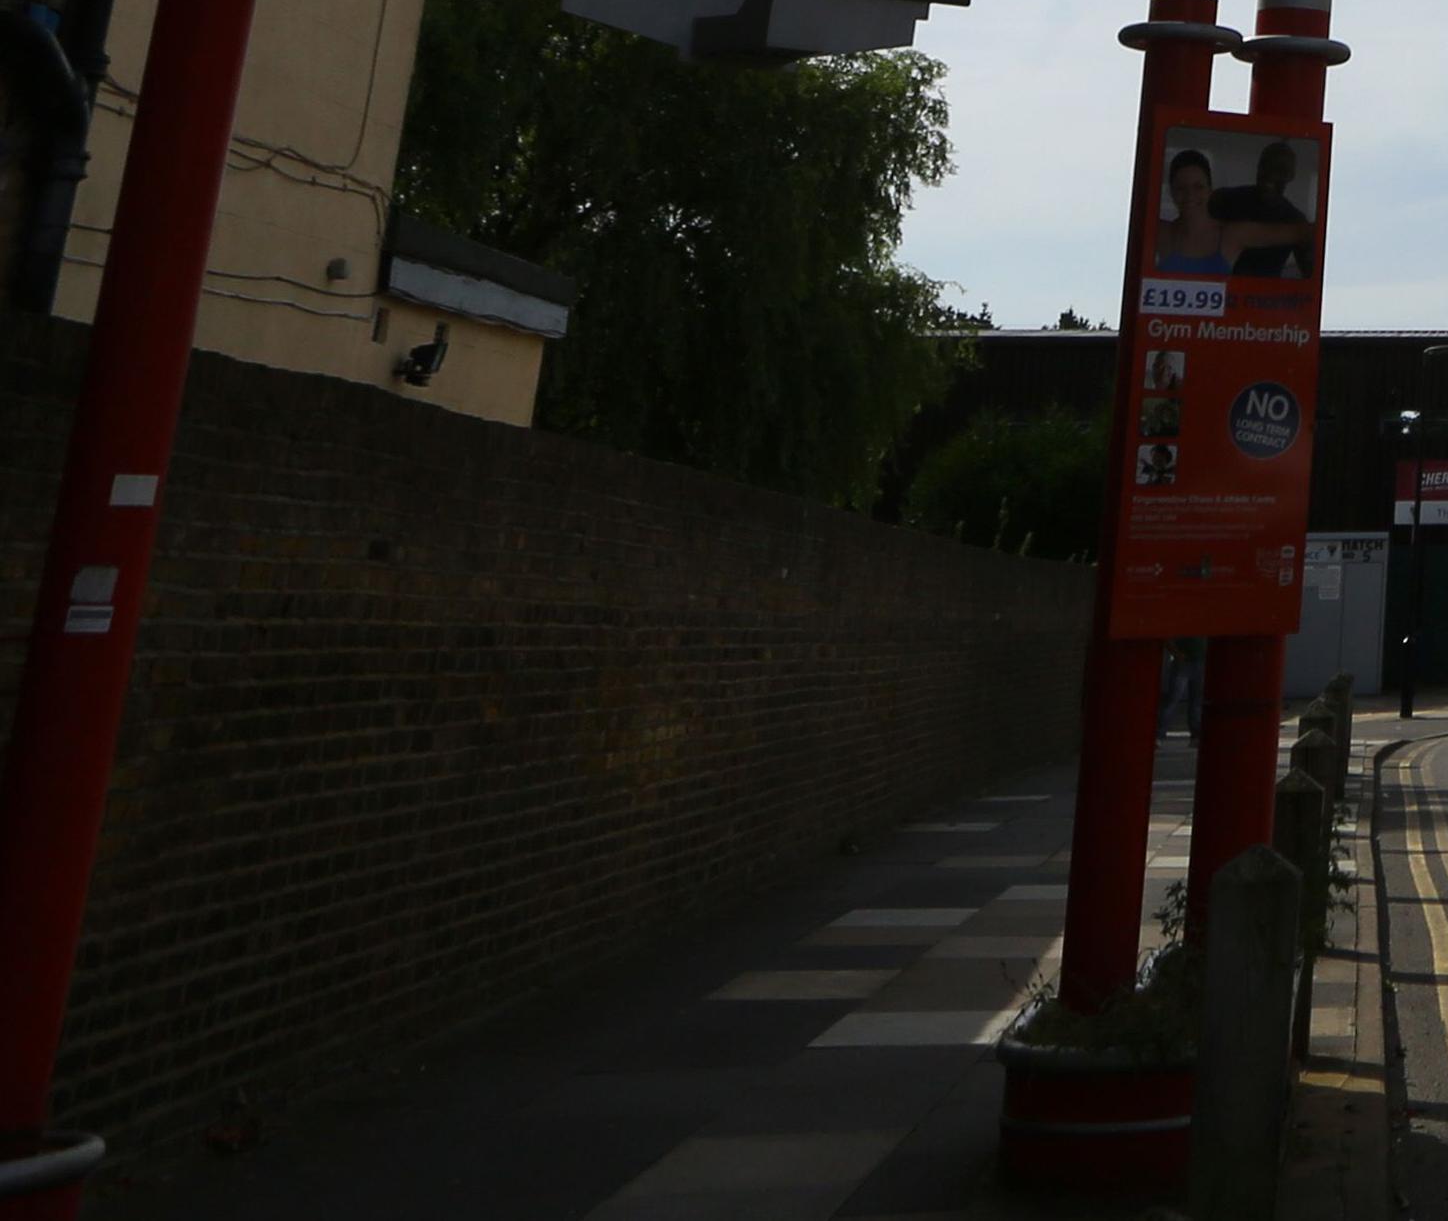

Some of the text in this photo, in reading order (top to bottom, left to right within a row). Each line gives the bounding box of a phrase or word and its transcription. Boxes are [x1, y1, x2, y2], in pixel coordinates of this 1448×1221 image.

[1143, 289, 1223, 309] £19.99
[1147, 319, 1311, 348] Gym Membership
[1246, 389, 1289, 421] NO
[1235, 418, 1291, 437] LONG TERM
[1235, 429, 1286, 449] CONTRACT
